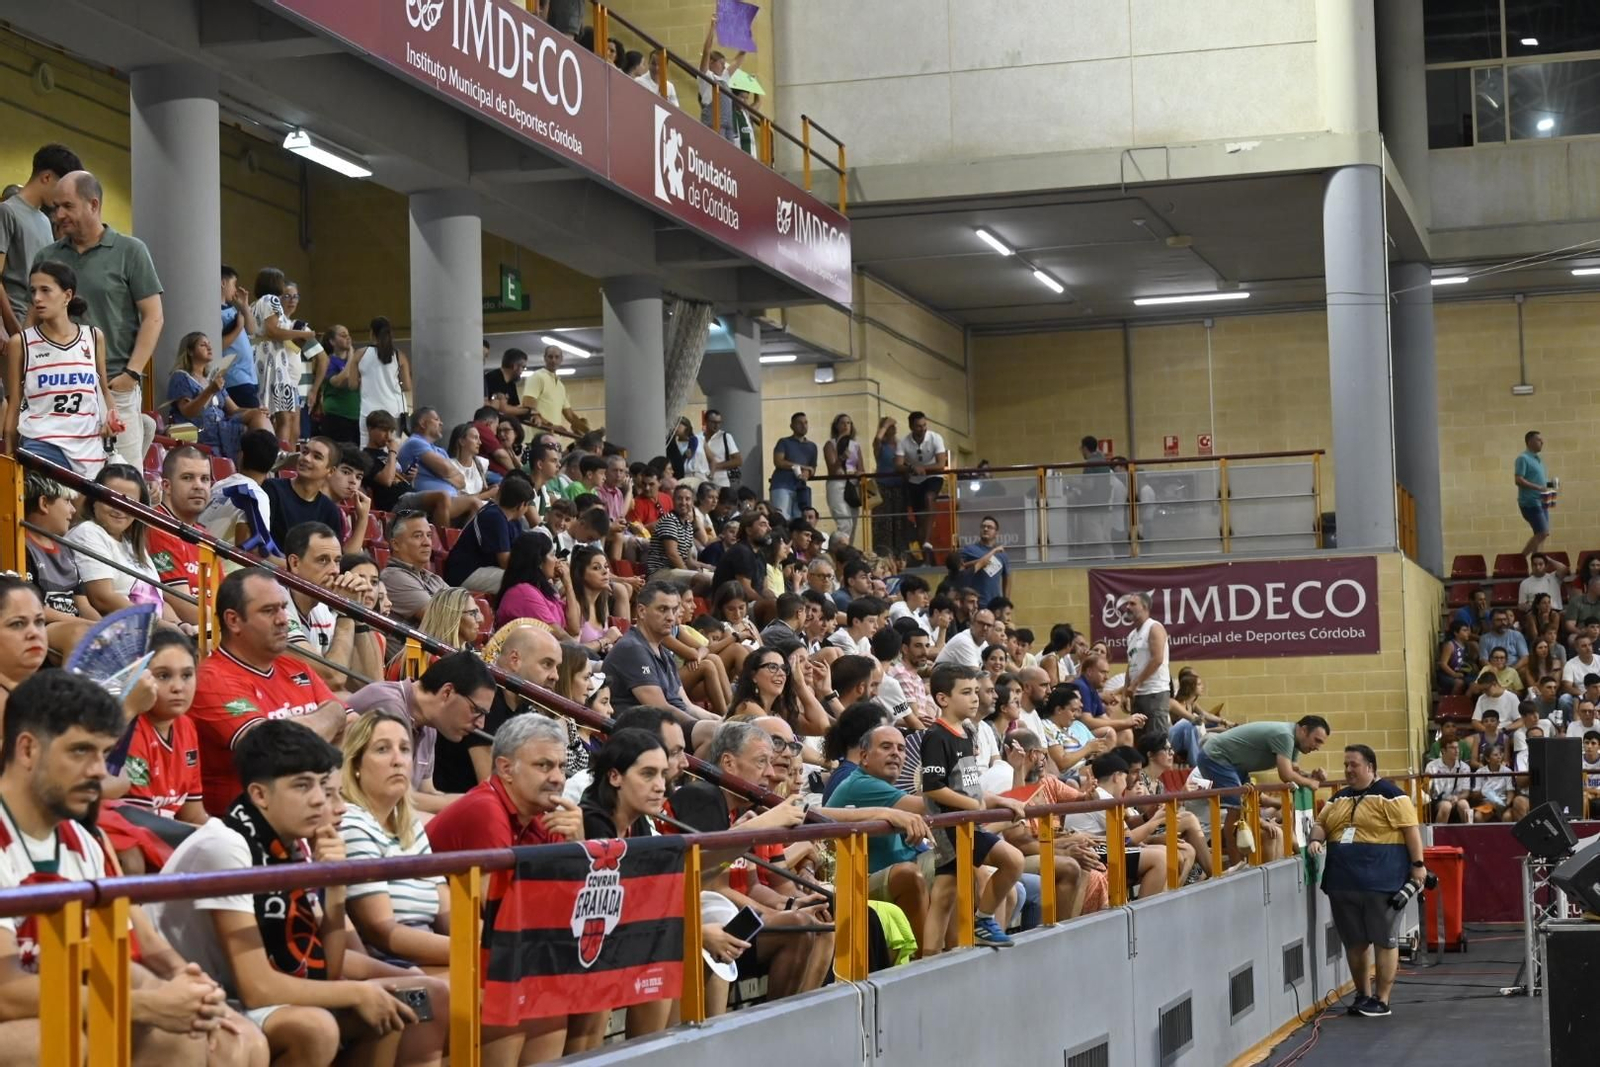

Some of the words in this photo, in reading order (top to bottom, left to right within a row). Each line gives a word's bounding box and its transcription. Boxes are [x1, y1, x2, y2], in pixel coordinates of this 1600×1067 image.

[452, 0, 583, 116] IMDECO
[406, 42, 447, 82] Instituto
[448, 66, 494, 108] Municipal
[495, 94, 508, 115] de
[508, 100, 548, 137] Deportes
[548, 121, 583, 156] Córdoba
[688, 146, 738, 198] Diputación
[688, 182, 701, 209] de
[702, 188, 739, 230] Córdoba
[508, 273, 516, 301] E
[38, 372, 95, 389] PULEVA
[53, 393, 83, 414] 23
[1163, 579, 1367, 625] IMDECO
[1226, 630, 1242, 642] de
[1246, 628, 1306, 645] Deportes
[1309, 626, 1366, 639] Córdoba
